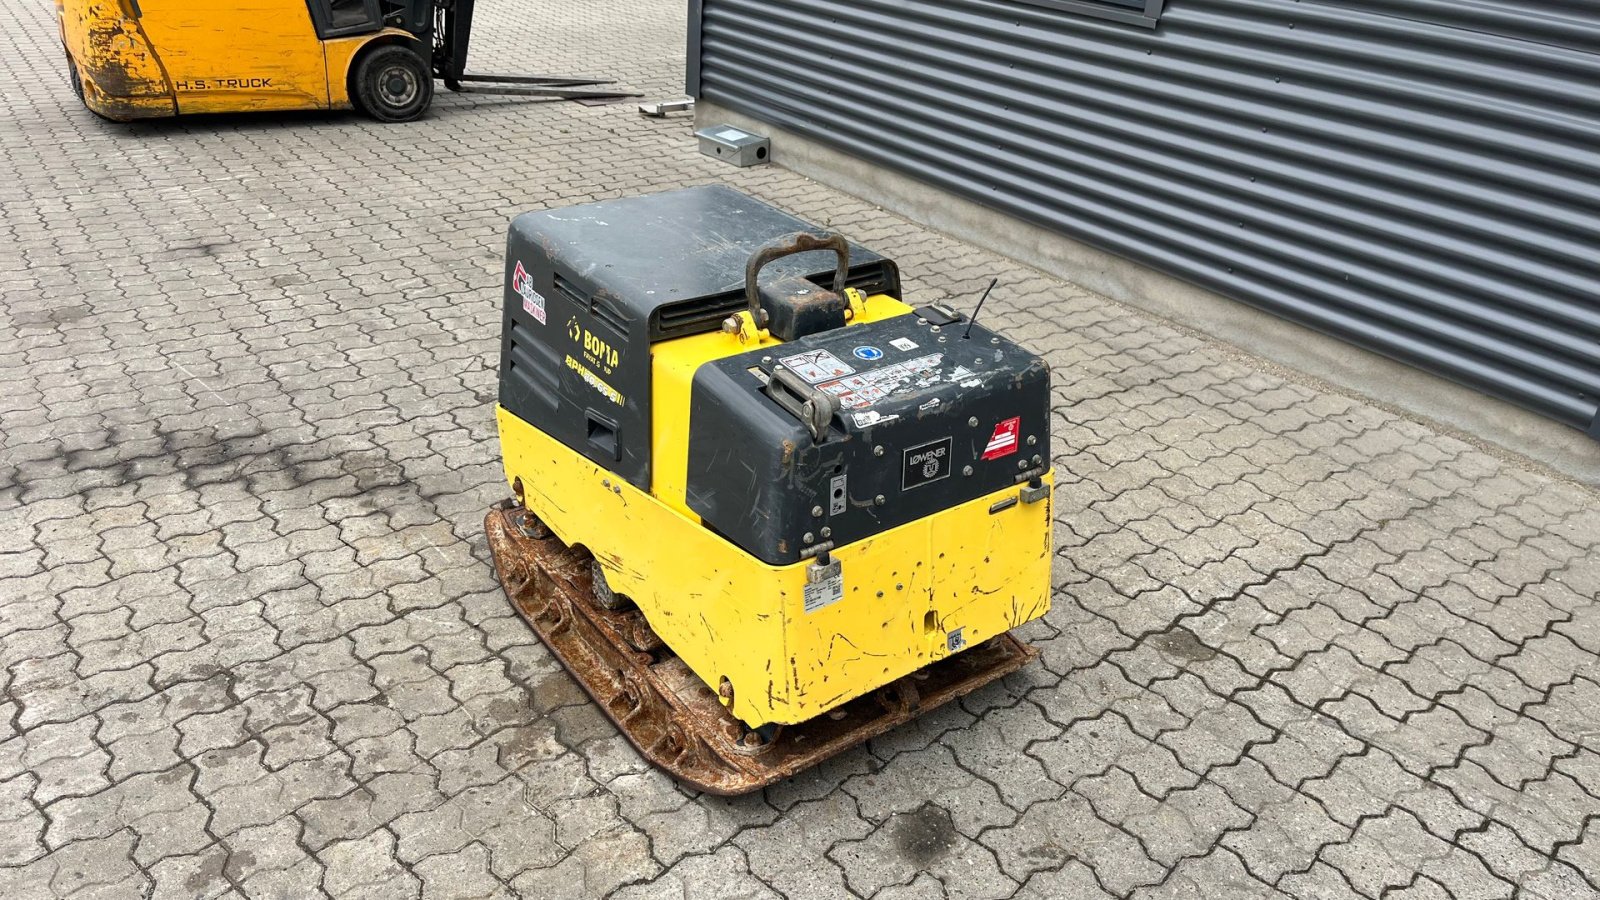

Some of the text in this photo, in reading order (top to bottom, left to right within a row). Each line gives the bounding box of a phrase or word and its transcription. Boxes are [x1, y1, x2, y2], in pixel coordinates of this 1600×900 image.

[176, 78, 273, 90] H.S. TRUCK
[909, 447, 945, 465] LØWENER
